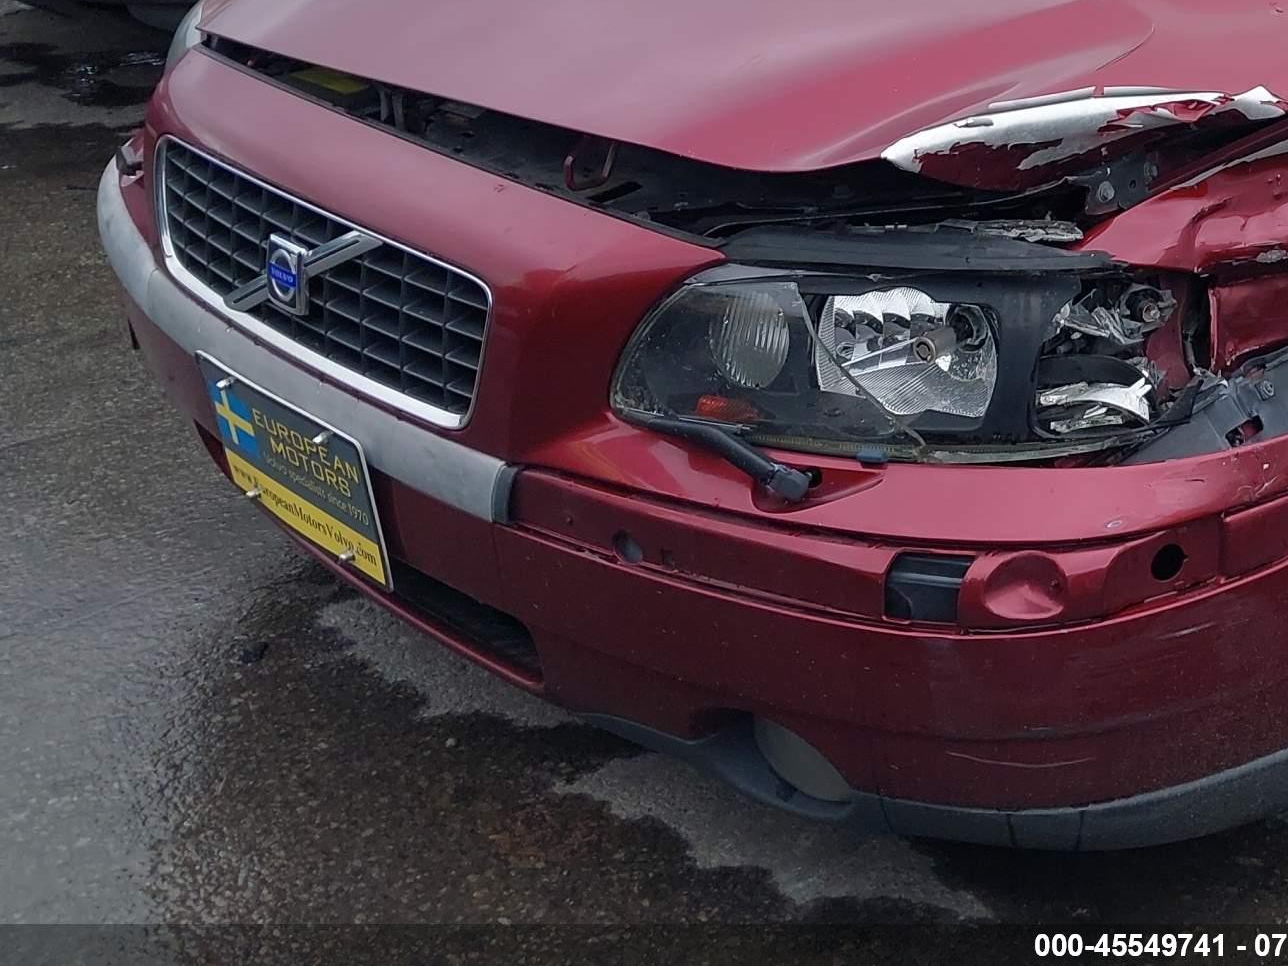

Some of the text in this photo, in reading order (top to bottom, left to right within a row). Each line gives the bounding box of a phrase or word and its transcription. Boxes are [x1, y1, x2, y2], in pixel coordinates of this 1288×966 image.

[271, 265, 294, 284] VOLVO
[252, 408, 359, 484] EUROPEAN
[270, 437, 351, 497] MOTORS
[347, 504, 370, 527] 1970
